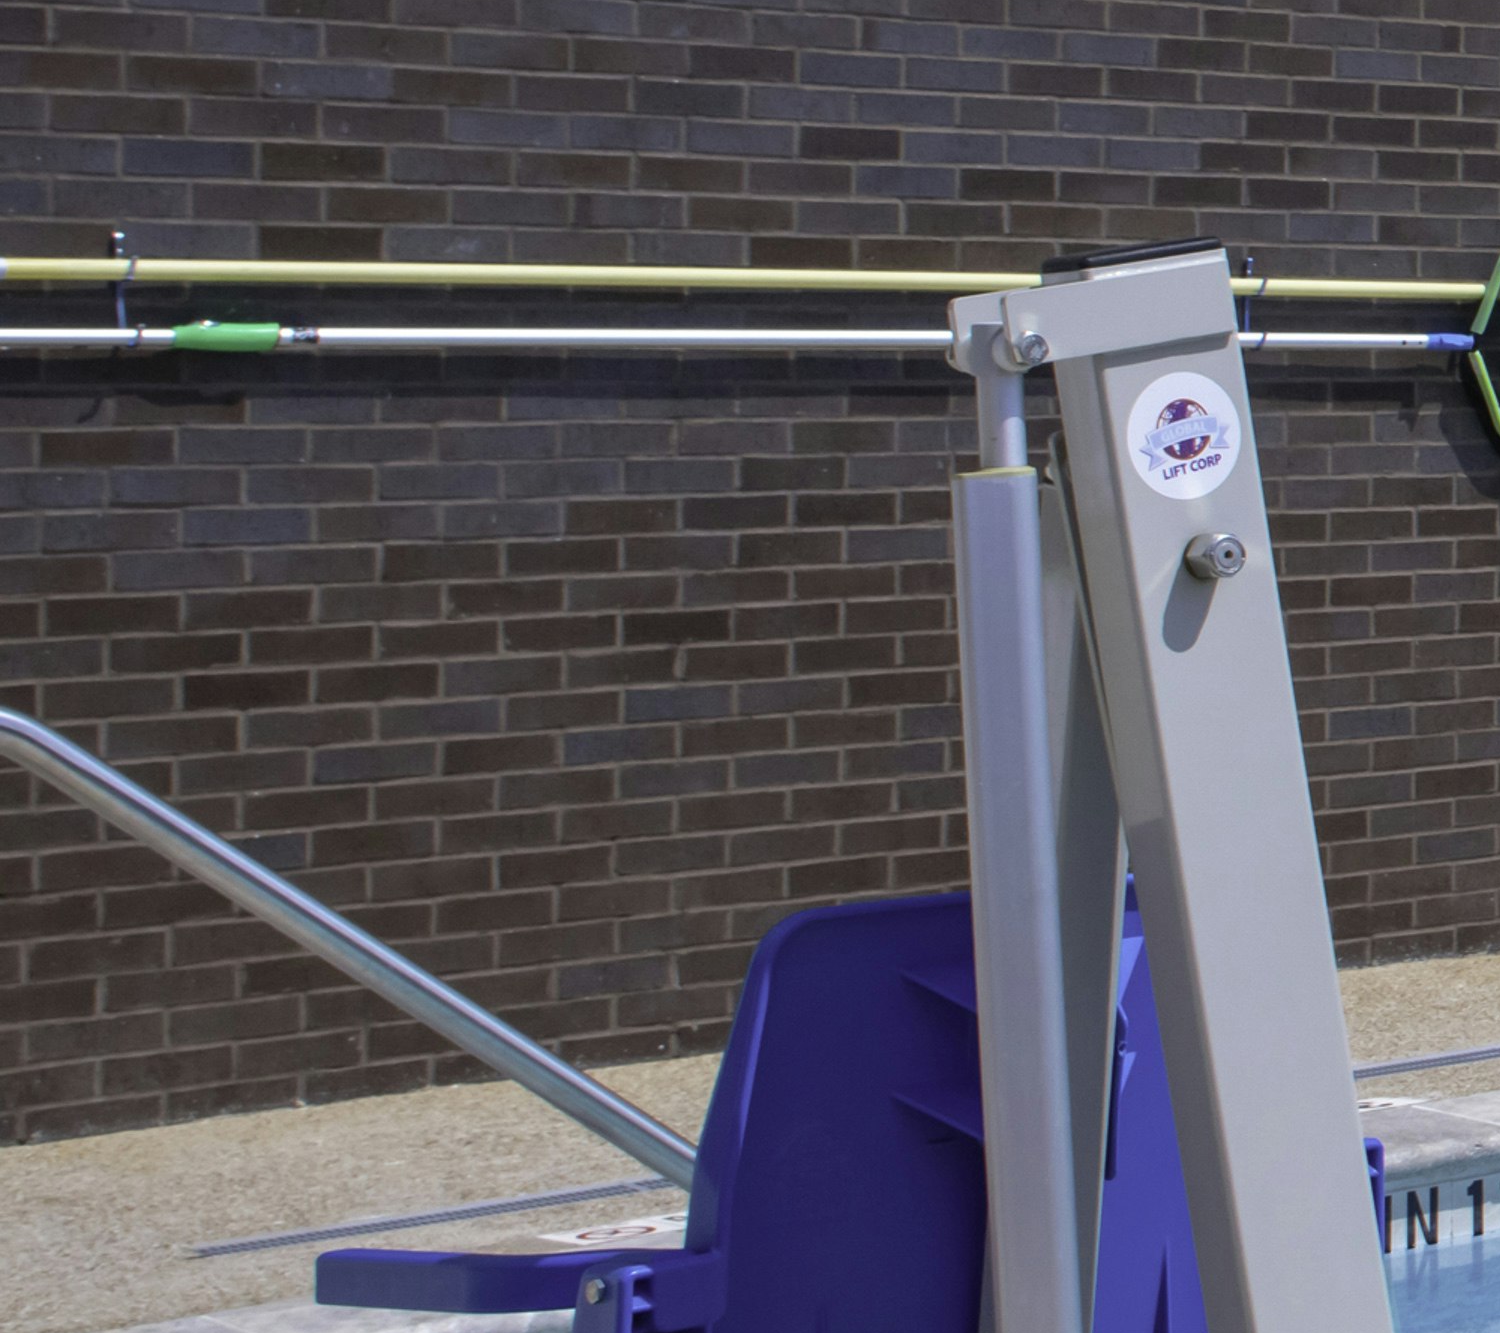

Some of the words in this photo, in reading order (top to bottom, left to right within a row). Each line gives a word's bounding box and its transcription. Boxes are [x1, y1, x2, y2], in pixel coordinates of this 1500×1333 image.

[1161, 420, 1207, 442] GLOBAL
[1162, 463, 1187, 480] LIFT
[1190, 454, 1222, 472] CORP
[1384, 1186, 1439, 1254] IN
